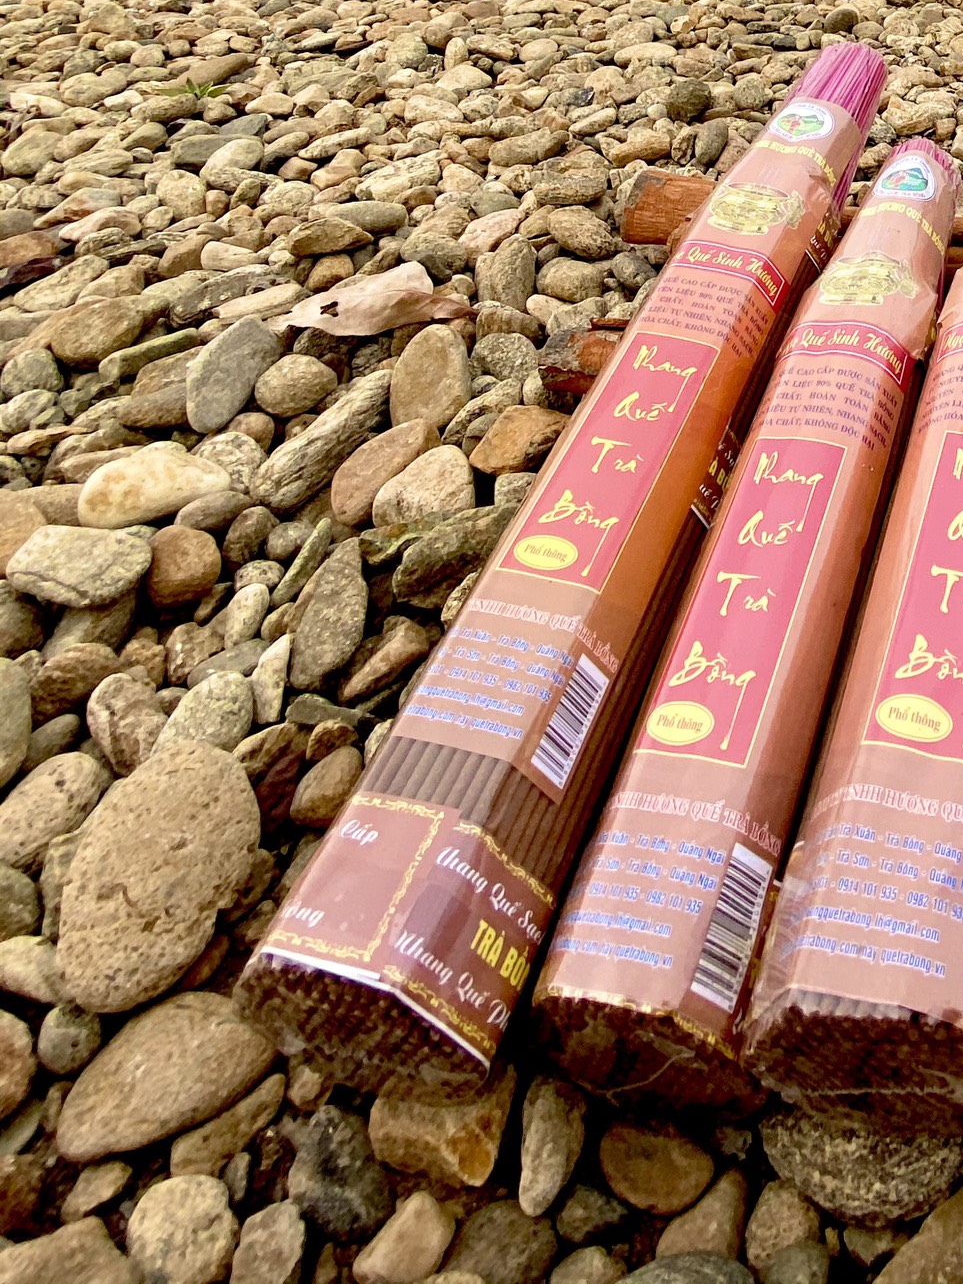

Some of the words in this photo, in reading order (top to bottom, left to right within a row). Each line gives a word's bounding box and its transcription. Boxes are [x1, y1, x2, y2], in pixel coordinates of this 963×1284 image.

[686, 245, 714, 263] Quế
[712, 251, 743, 269] Sinh
[745, 258, 778, 297] Hương
[800, 328, 830, 348] Quế
[828, 329, 860, 346] Sinh
[863, 333, 902, 373] Hương
[633, 345, 698, 413] Nhang
[614, 391, 667, 421] Quế
[591, 436, 643, 473] Trà
[754, 451, 824, 532] Nhang
[538, 489, 619, 577] Bồng
[738, 510, 796, 548] Quế
[524, 542, 542, 555] Phổ
[542, 547, 568, 563] thông
[716, 571, 776, 616] Trà
[523, 683, 537, 695] 101
[538, 688, 552, 703] 935
[669, 640, 756, 750] Bồng
[657, 713, 676, 728] Phổ
[677, 716, 704, 732] thông
[888, 705, 909, 723] Phổ
[910, 711, 941, 732] thông
[489, 882, 522, 918] Quế
[645, 890, 667, 906] 0982
[668, 895, 683, 910] 101
[685, 898, 703, 914] 935
[837, 877, 859, 893] 0914
[863, 882, 878, 896] 101
[881, 886, 898, 901] 935
[906, 891, 930, 908] 0982
[933, 897, 948, 913] 101
[469, 918, 505, 968] TRÀ
[457, 971, 490, 1008] Quế
